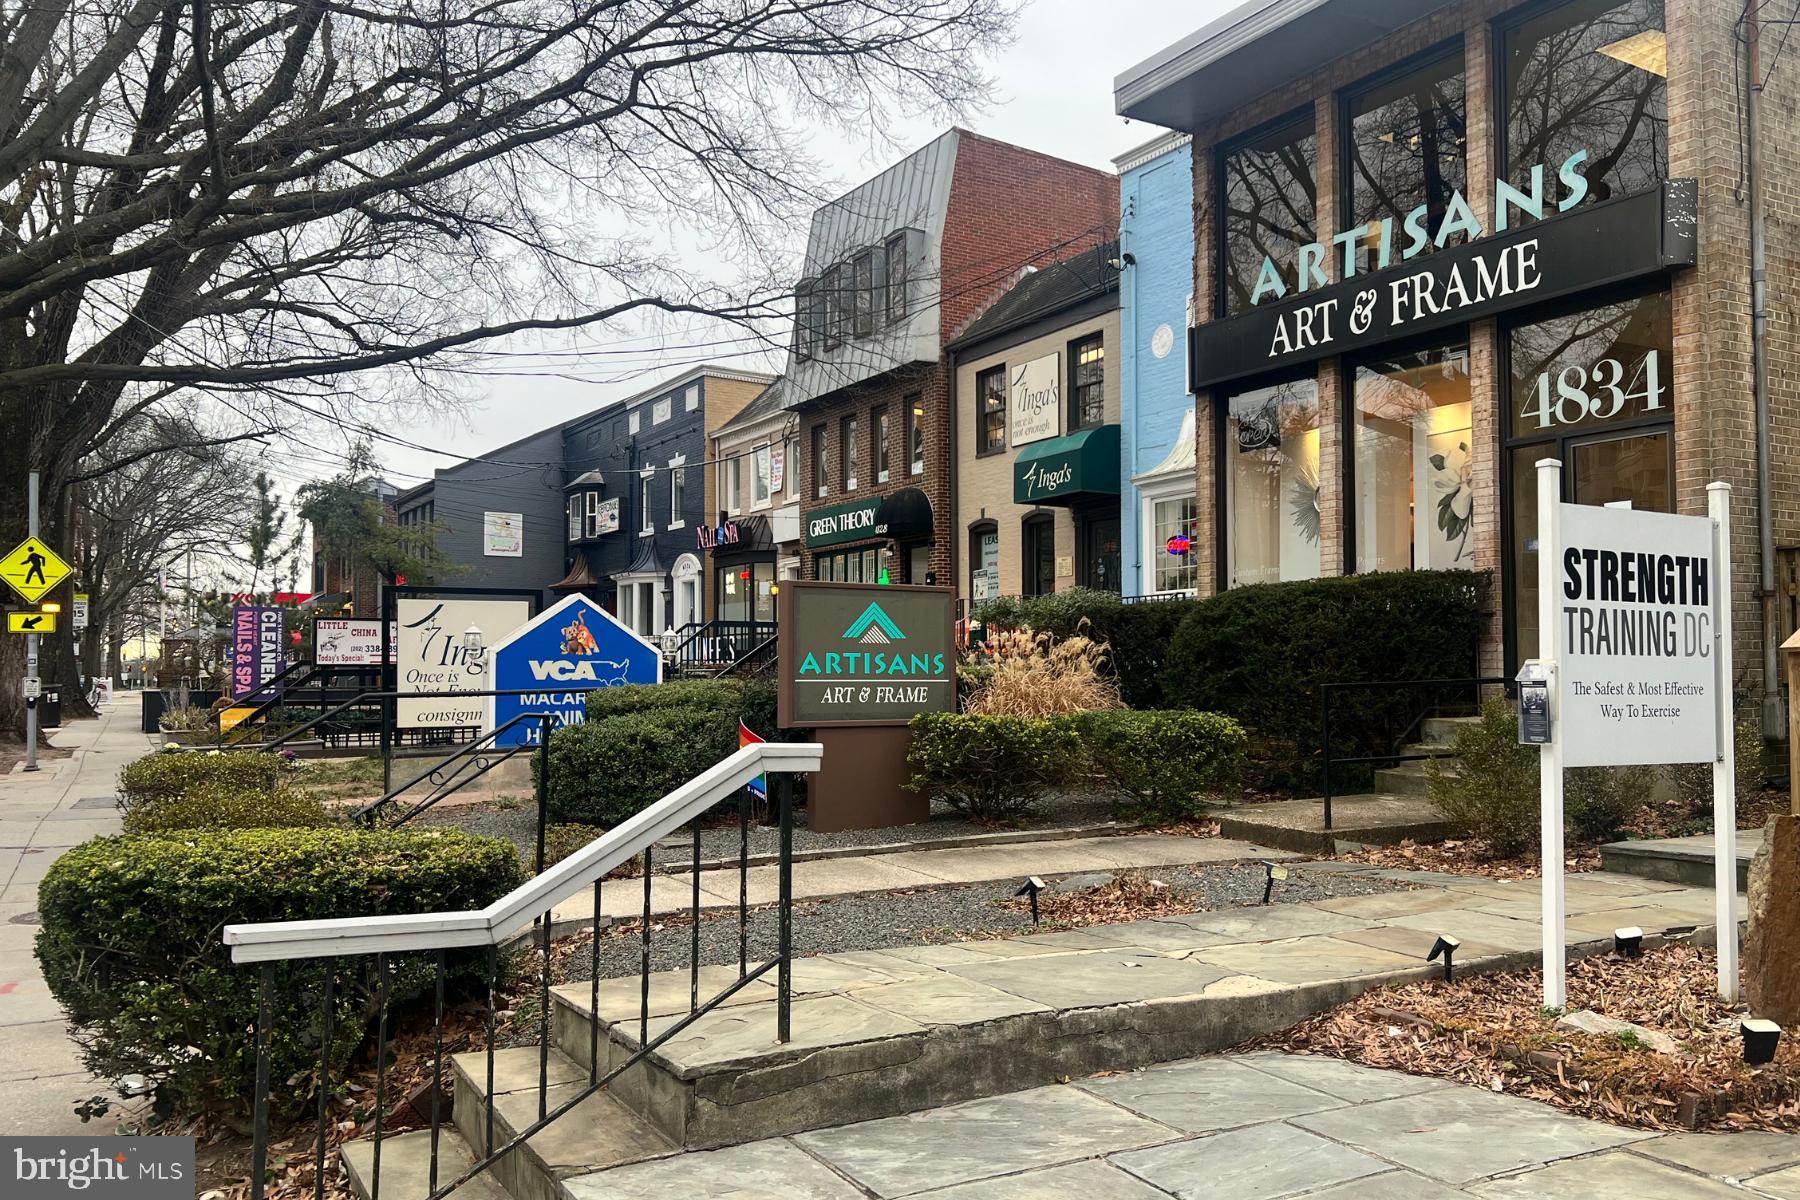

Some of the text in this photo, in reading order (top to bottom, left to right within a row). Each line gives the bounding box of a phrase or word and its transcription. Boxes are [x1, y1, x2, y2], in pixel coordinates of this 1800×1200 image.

[1250, 149, 1589, 306] ARTISANS
[1268, 238, 1542, 358] ART & FRAME
[1022, 379, 1058, 416] Inga's
[1520, 349, 1666, 430] 4834
[1024, 418, 1051, 436] enough
[1037, 463, 1072, 491] Inga's
[697, 521, 739, 549] NAIL SPA
[809, 508, 876, 538] GREEN THEORY
[1563, 547, 1709, 606] STRENGTH
[74, 609, 85, 618] 15
[237, 611, 253, 652] NAILS
[318, 622, 348, 630] LITTLE
[351, 629, 377, 637] CHINA
[1563, 606, 1710, 658] TRAINING DC
[236, 653, 252, 664] &
[317, 654, 340, 663] Today's
[528, 660, 598, 681] VCA
[799, 651, 945, 675] ARTISANS
[235, 666, 252, 694] SPA
[406, 669, 459, 684] Once is
[1572, 681, 1705, 696] The Safest & Most Effective
[821, 686, 928, 704] ART & FRAME
[1600, 703, 1681, 722] Way To Exercise
